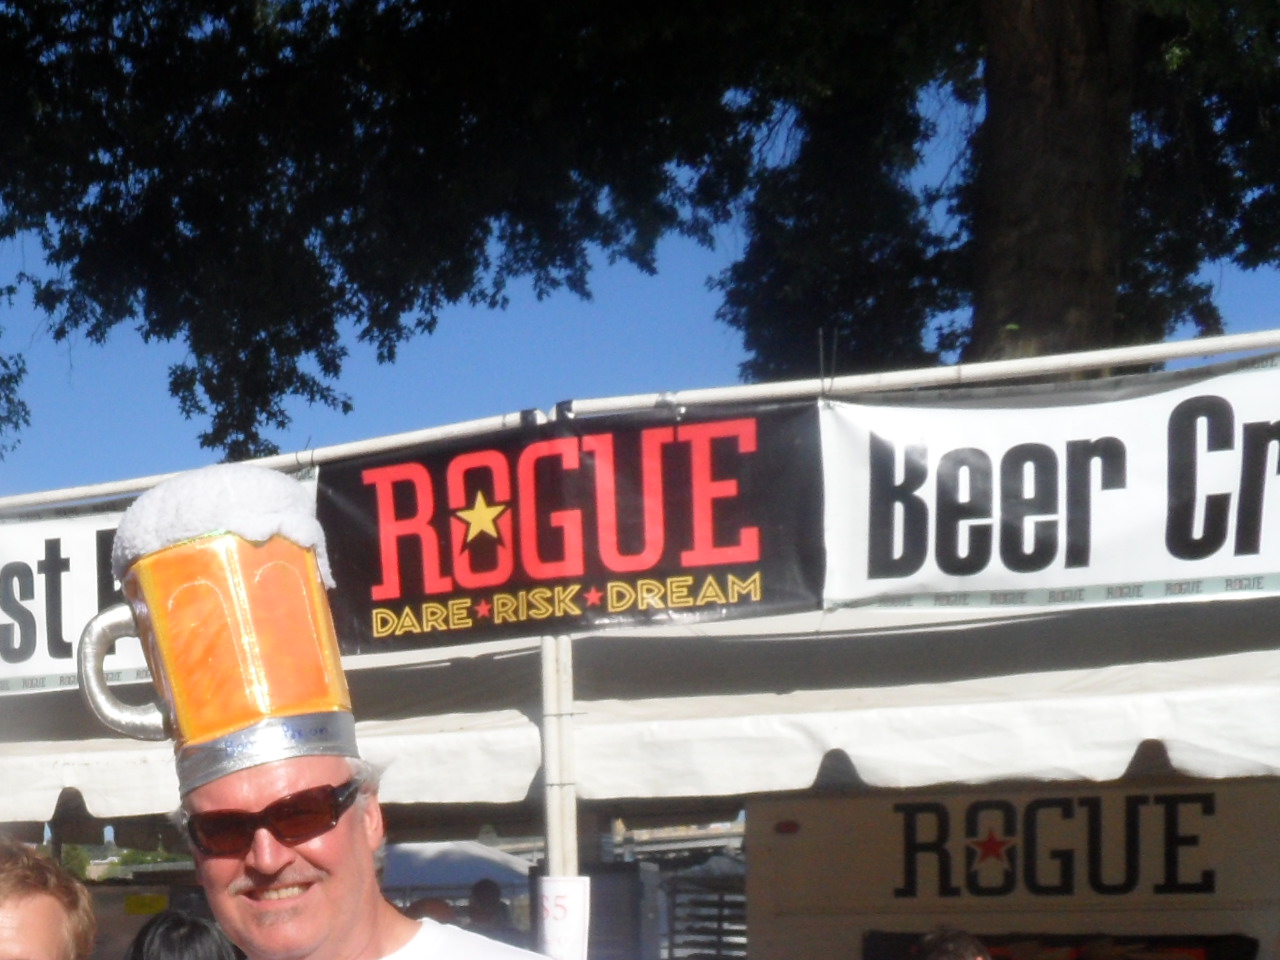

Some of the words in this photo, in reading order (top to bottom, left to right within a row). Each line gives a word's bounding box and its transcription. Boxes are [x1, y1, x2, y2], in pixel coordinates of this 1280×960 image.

[361, 418, 761, 601] ROGUE
[867, 430, 1127, 580] Beer
[373, 600, 472, 638] DARE
[494, 584, 581, 624] RISK
[607, 572, 761, 613] DREAM
[1224, 576, 1264, 591] ROGUE
[894, 793, 1216, 898] ROGUE
